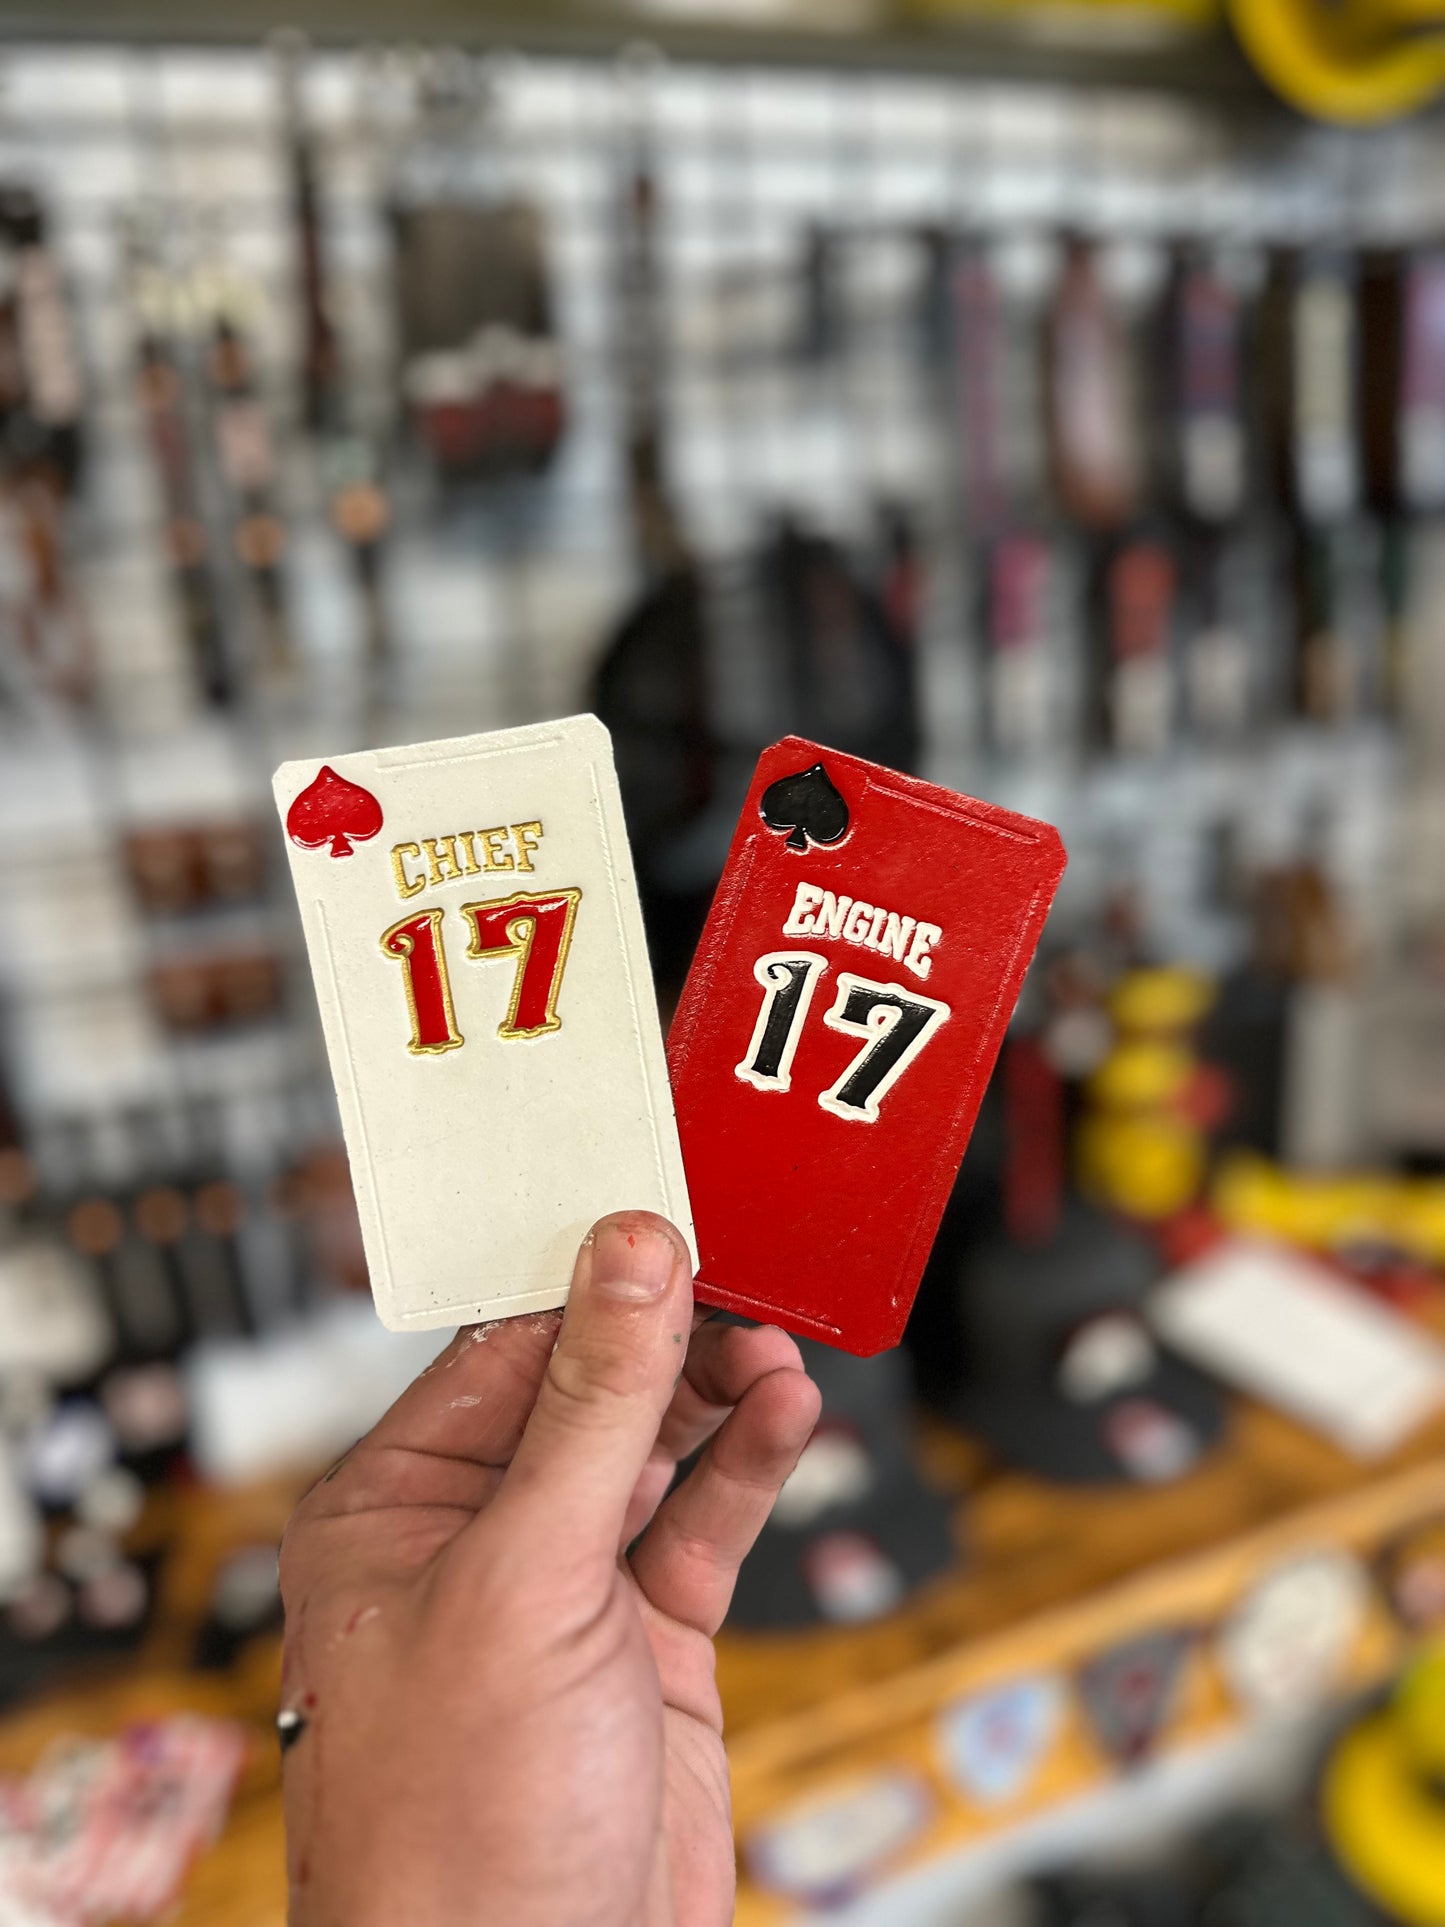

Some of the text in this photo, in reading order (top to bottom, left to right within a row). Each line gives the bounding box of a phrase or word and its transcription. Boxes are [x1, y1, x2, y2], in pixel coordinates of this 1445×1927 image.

[390, 821, 544, 899] CHIEF
[380, 887, 582, 1055] 17
[782, 881, 942, 979] ENGINE
[735, 951, 951, 1123] 17
